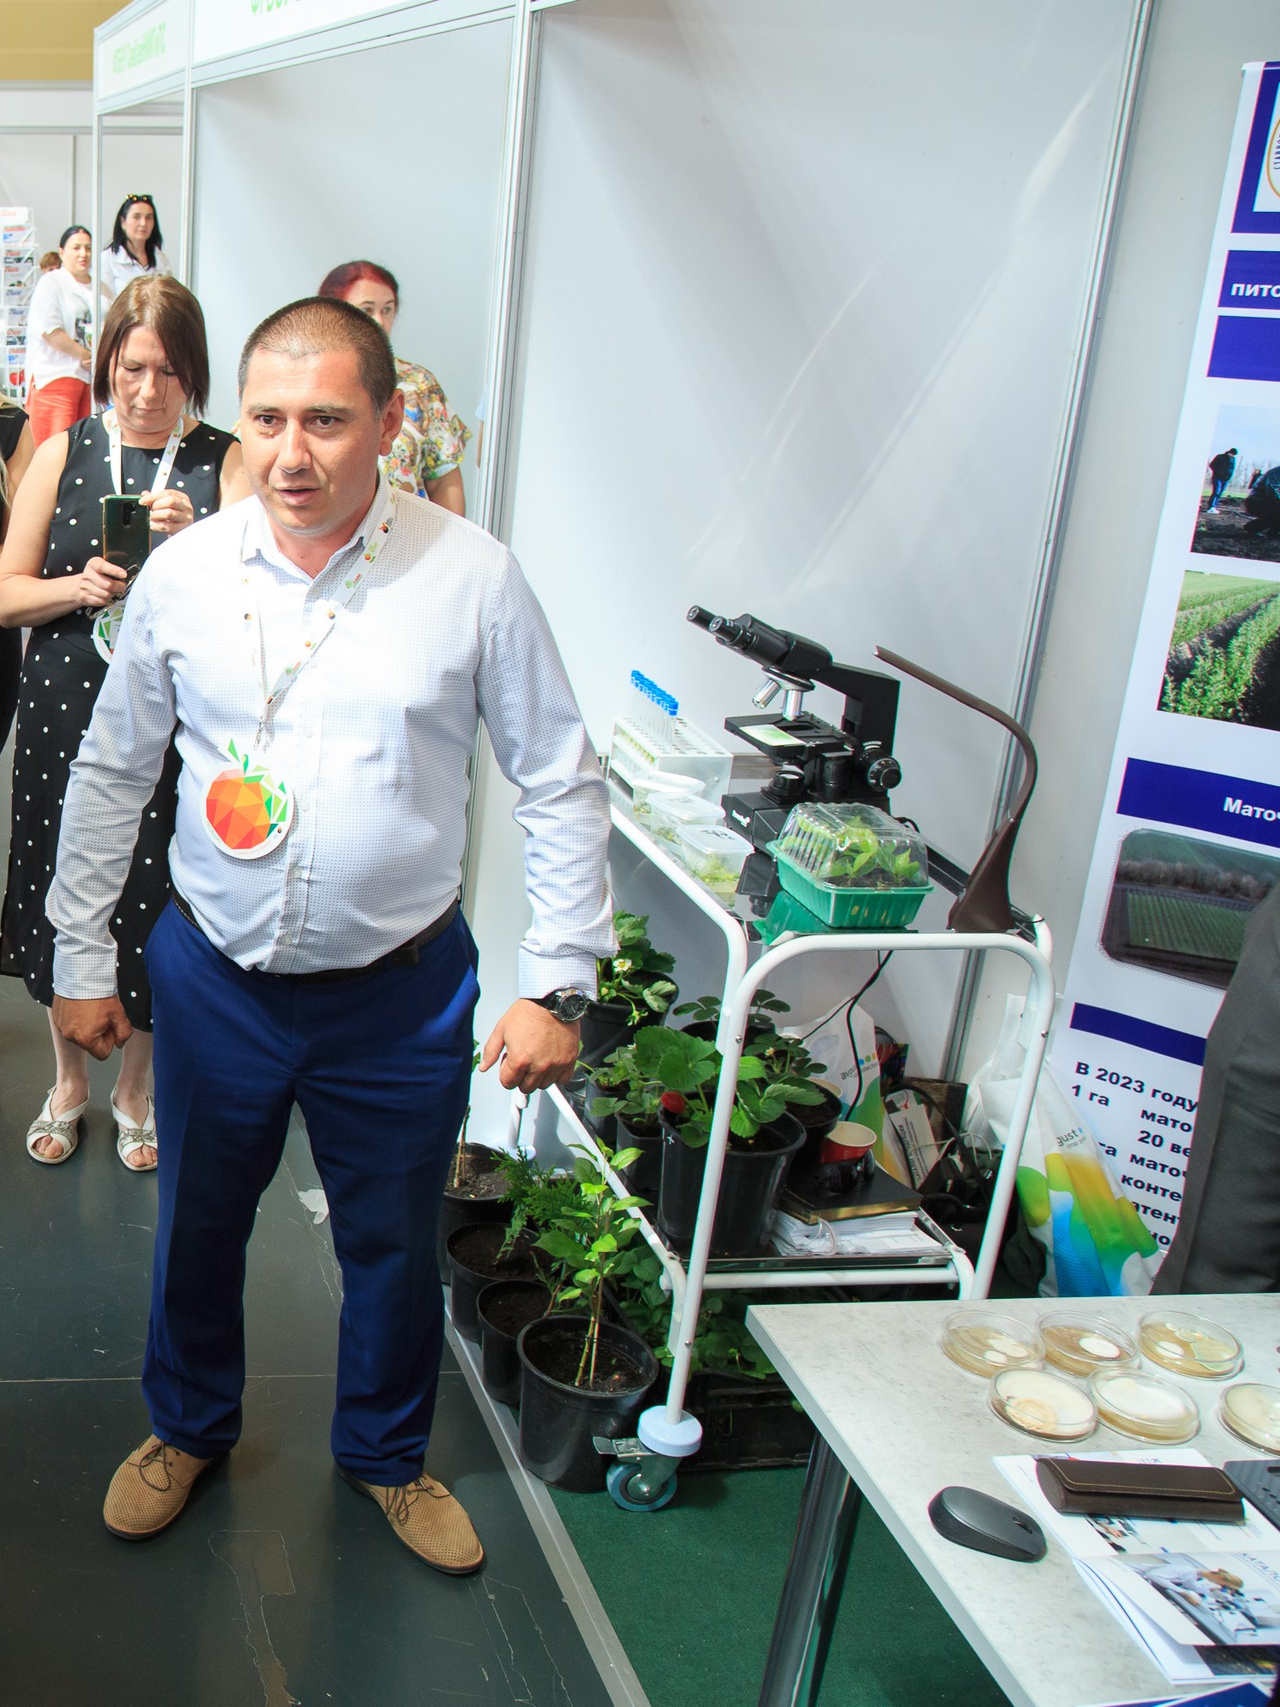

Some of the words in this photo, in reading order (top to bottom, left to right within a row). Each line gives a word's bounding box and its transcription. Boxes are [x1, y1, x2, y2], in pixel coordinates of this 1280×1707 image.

[1075, 1061, 1090, 1075] В
[1095, 1067, 1146, 1094] 2023
[1151, 1088, 1199, 1113] году
[1071, 1084, 1081, 1097] 1
[1088, 1091, 1110, 1107] га
[1140, 1109, 1193, 1133] мато
[1137, 1130, 1165, 1148] 20
[1169, 1142, 1191, 1158] ве
[1121, 1174, 1183, 1202] конте
